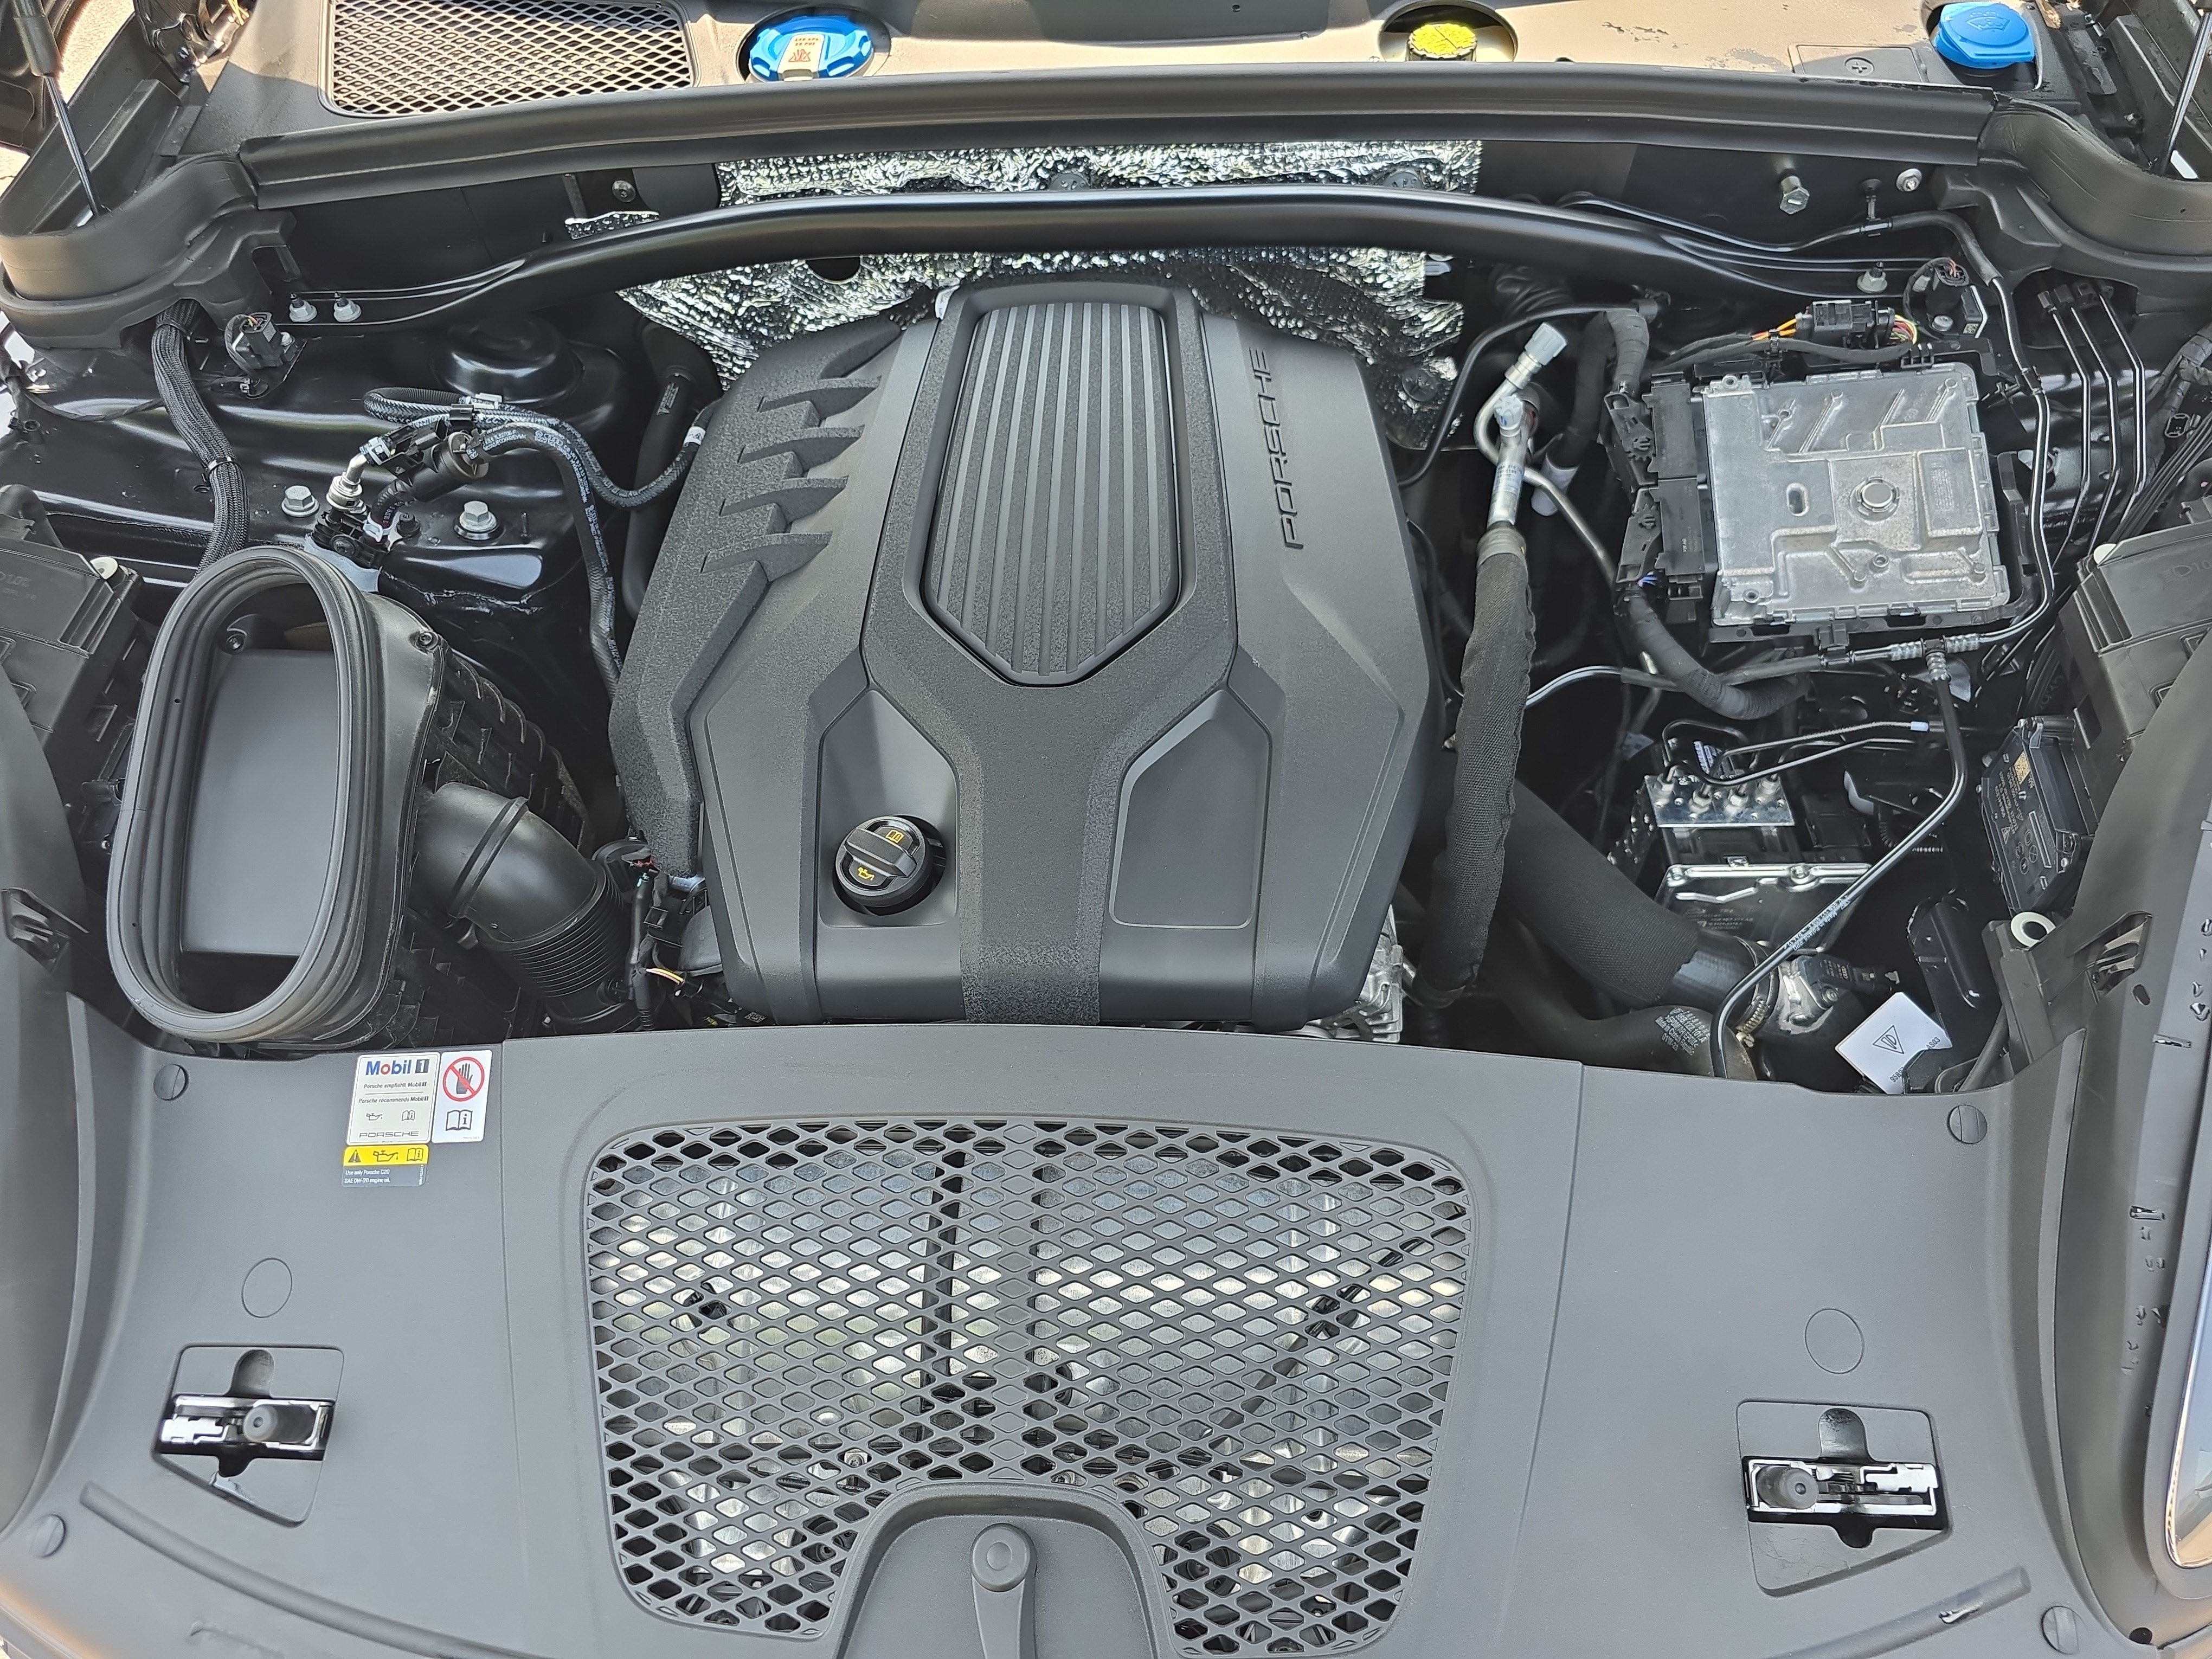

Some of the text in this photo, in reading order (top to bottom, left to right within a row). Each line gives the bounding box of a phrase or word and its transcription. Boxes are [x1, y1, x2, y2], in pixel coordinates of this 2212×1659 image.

[1249, 347, 1304, 549] PORSCHE
[1823, 910, 1837, 923] Made
[365, 1059, 430, 1076] Mobil 1
